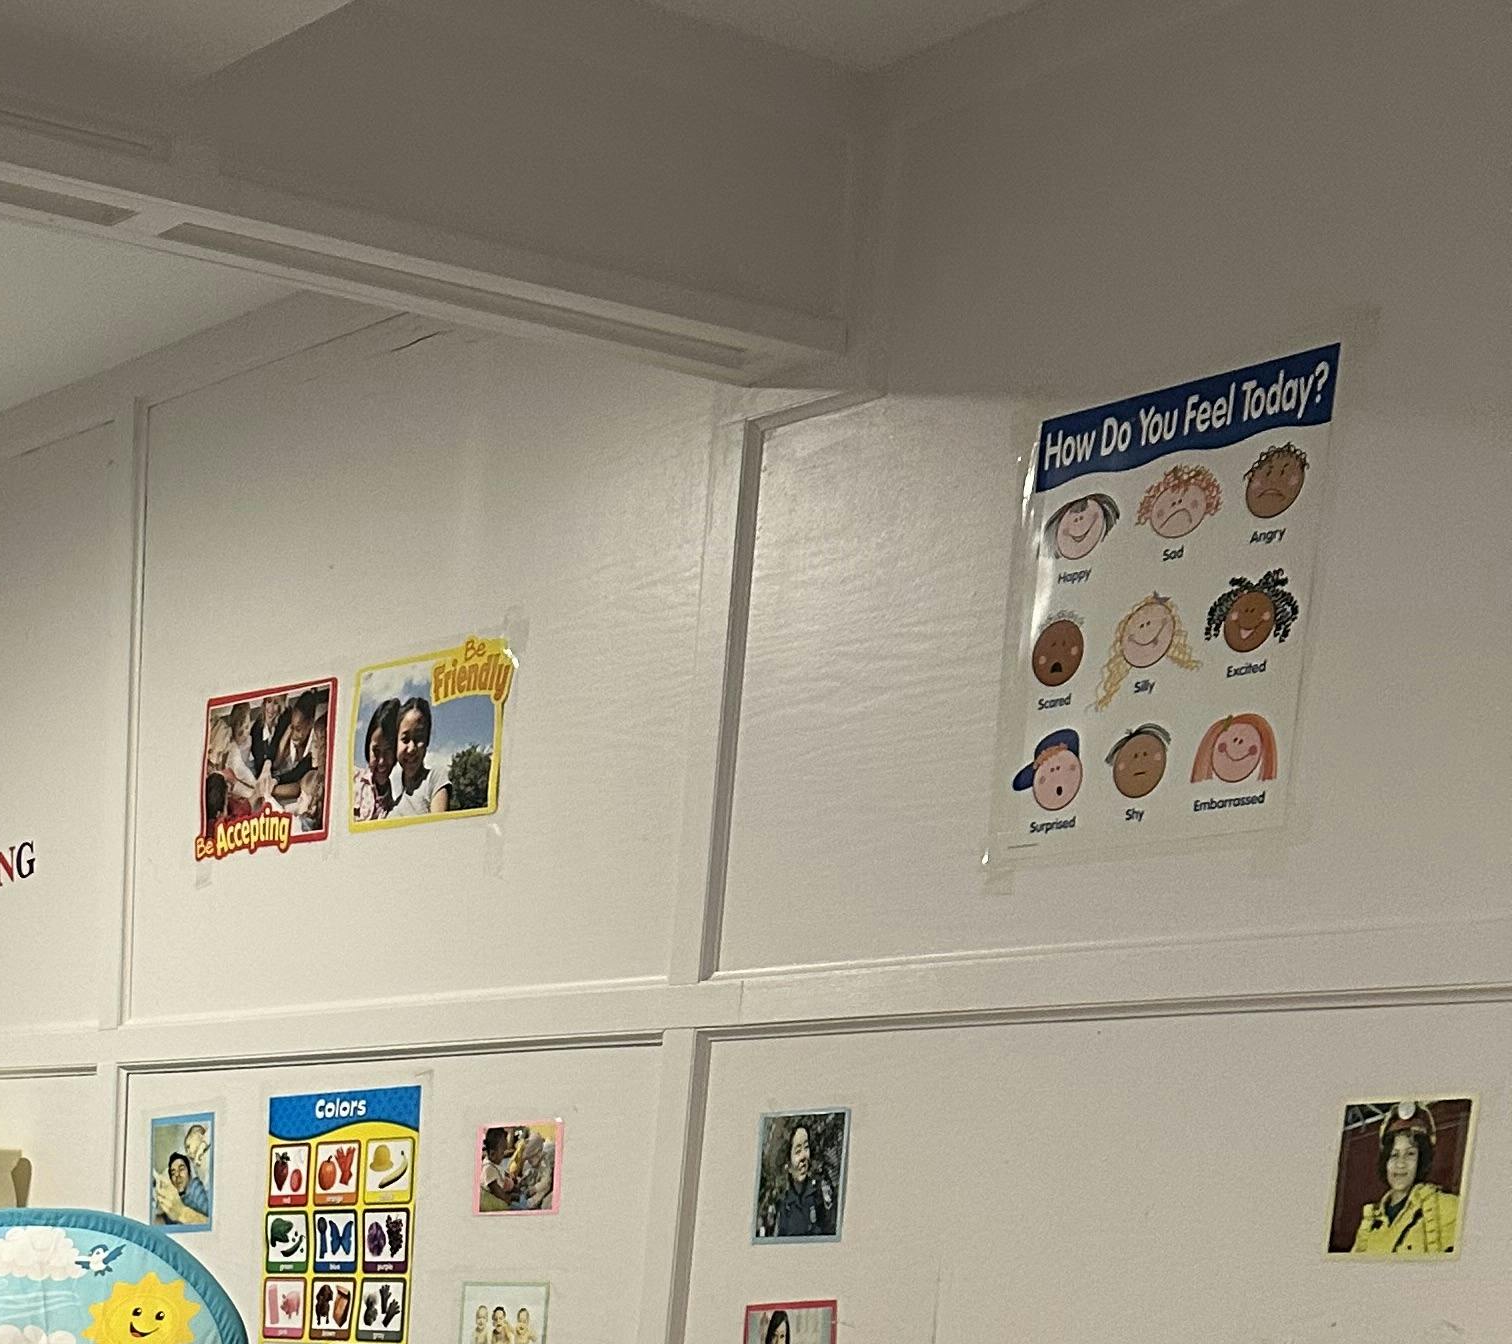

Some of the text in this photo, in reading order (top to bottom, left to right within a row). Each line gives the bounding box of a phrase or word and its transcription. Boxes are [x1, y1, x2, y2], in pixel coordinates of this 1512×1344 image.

[1043, 360, 1330, 471] How Do You Feel Today?
[1249, 526, 1287, 545] Angry
[1162, 544, 1184, 562] Sad
[1057, 566, 1092, 584] Happy
[465, 639, 487, 662] Be
[431, 653, 513, 702] Friendly
[1226, 659, 1267, 678] Excited
[1134, 678, 1156, 695] Silly
[1038, 693, 1072, 710] Scared
[1193, 791, 1266, 812] Embarrassed
[1125, 808, 1144, 821] Shy
[196, 808, 290, 859] Be Accepting
[1029, 816, 1077, 834] Surprised
[315, 1097, 367, 1120] Colors
